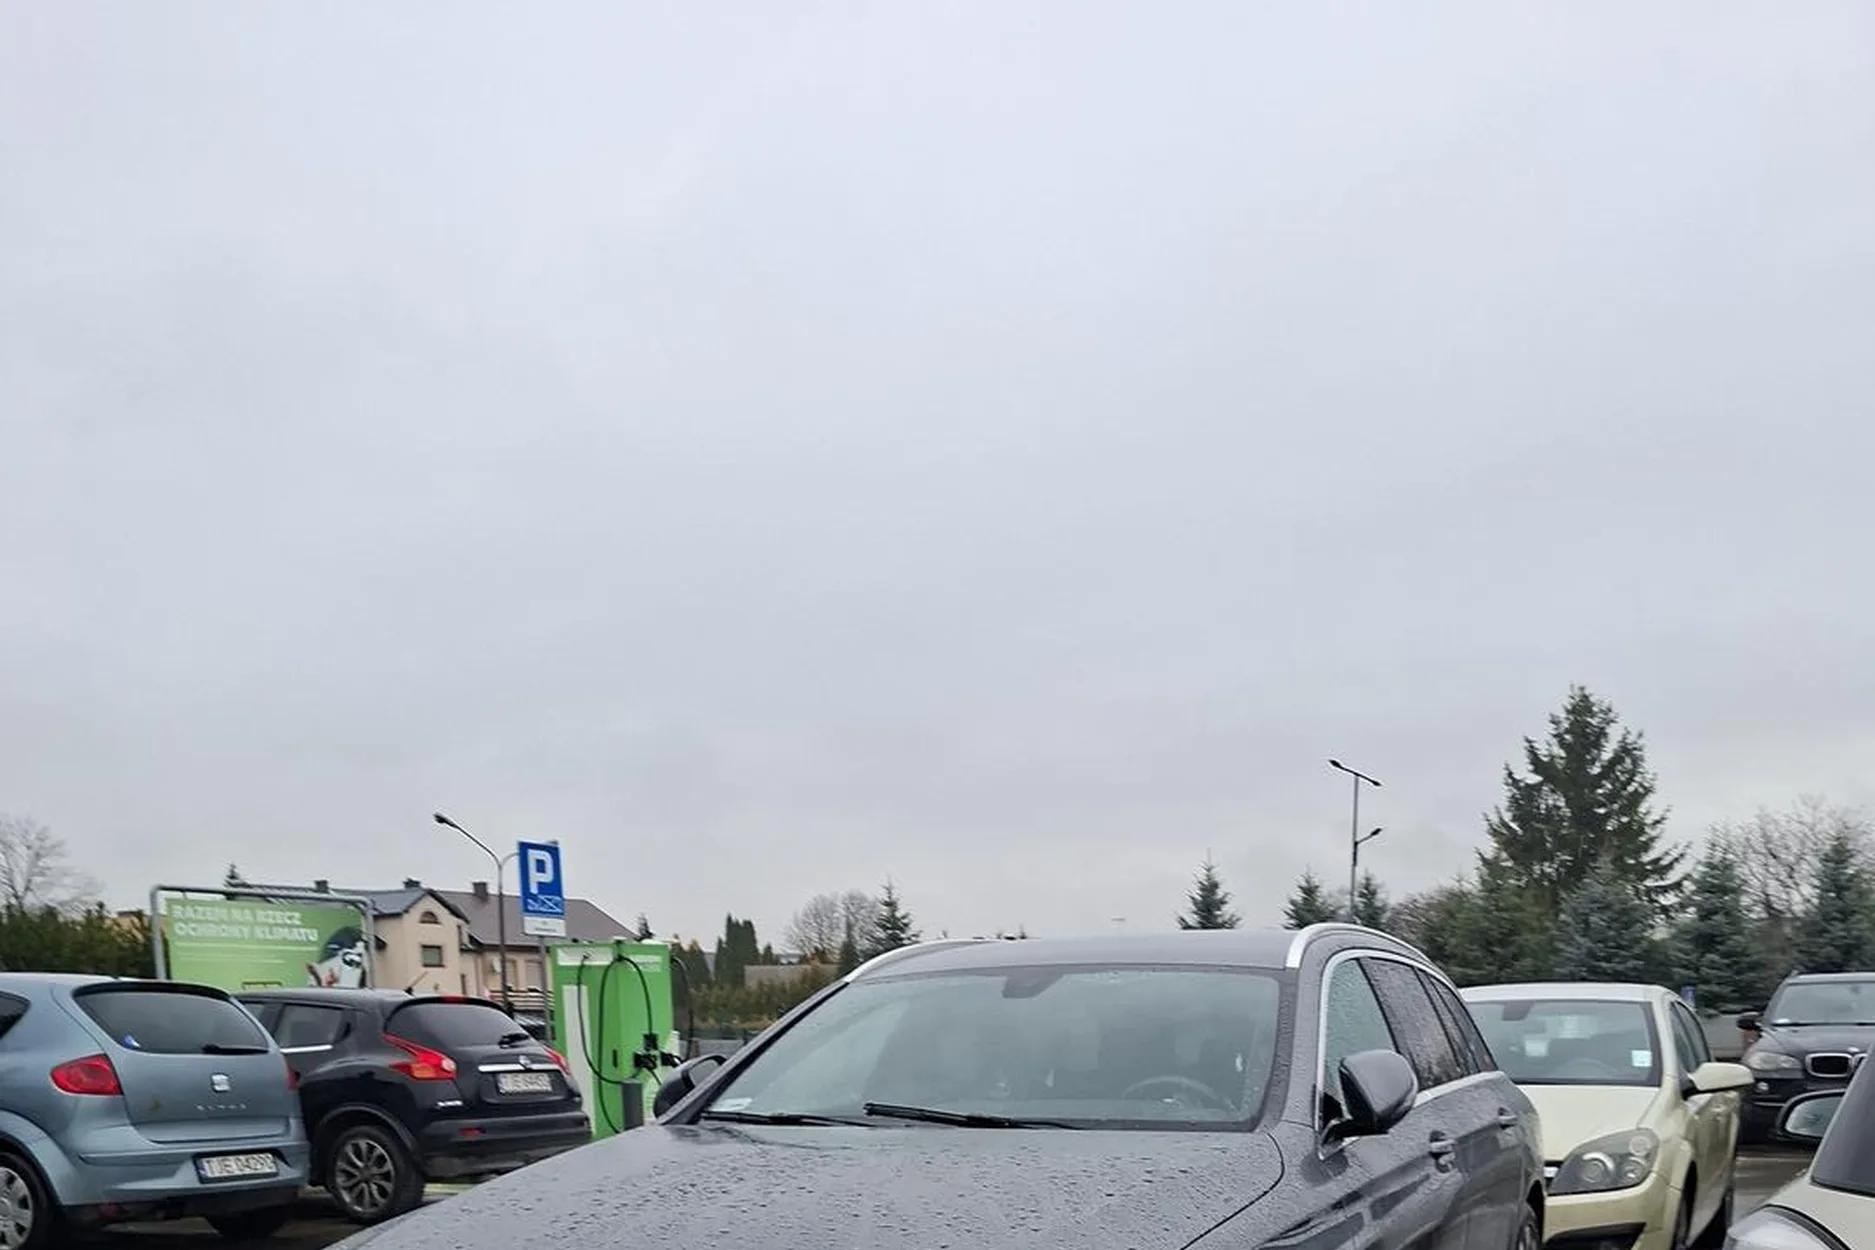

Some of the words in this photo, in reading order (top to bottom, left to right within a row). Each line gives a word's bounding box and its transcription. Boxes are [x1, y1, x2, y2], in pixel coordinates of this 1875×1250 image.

[527, 848, 554, 895] P
[172, 905, 227, 921] RAZEM
[231, 908, 254, 922] NA
[256, 909, 302, 925] RZECZ
[174, 922, 249, 939] OCHRONY
[253, 926, 319, 942] KLIMATU
